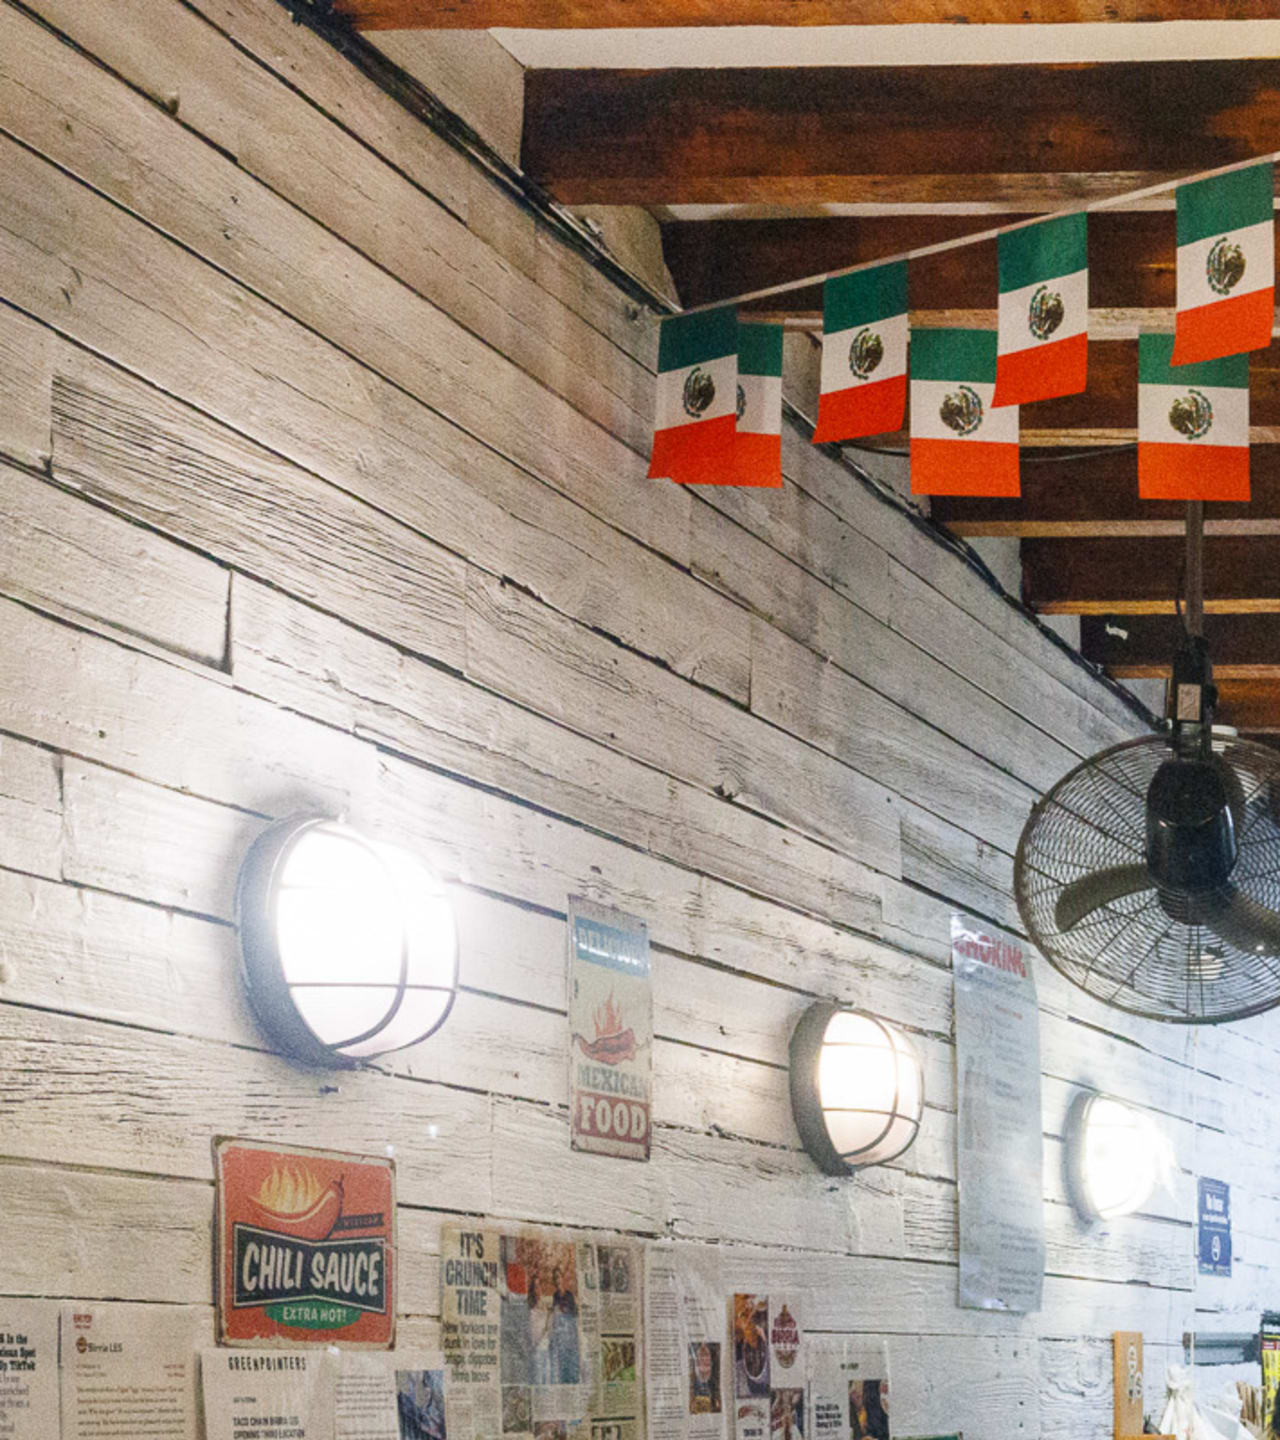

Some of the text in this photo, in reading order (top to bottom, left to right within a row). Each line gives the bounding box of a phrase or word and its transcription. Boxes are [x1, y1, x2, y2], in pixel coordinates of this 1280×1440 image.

[579, 1064, 646, 1098] MEXICAN
[580, 1097, 646, 1139] FOOD
[460, 1232, 484, 1259] IT'S
[242, 1241, 381, 1297] CHILI SAUCE
[445, 1260, 498, 1288] CRUNCH
[283, 1306, 347, 1323] EXTRA HOT!
[456, 1289, 487, 1316] TIME
[228, 1356, 307, 1371] GREENPOINTERS
